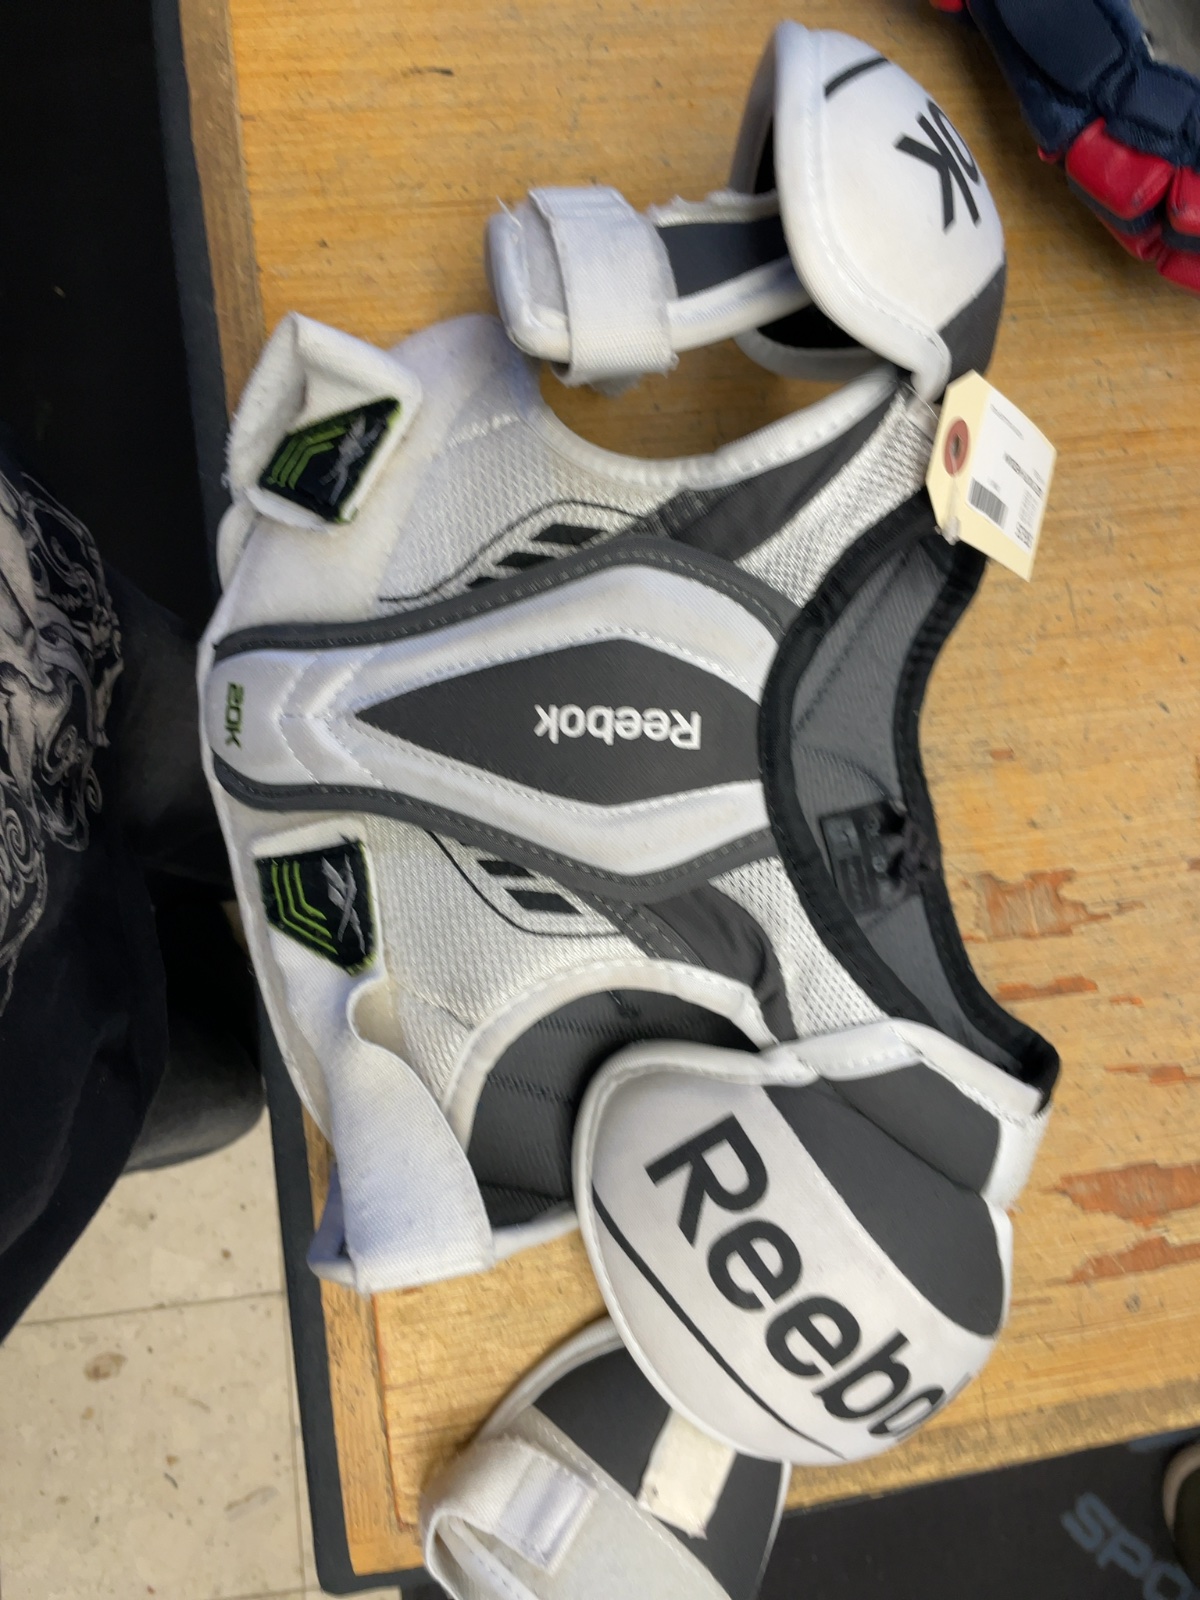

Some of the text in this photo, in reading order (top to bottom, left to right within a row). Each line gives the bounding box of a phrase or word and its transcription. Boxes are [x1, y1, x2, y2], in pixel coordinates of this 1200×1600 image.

[225, 682, 244, 750] 20K
[533, 703, 702, 751] Reebok
[644, 1110, 972, 1441] Reebo
